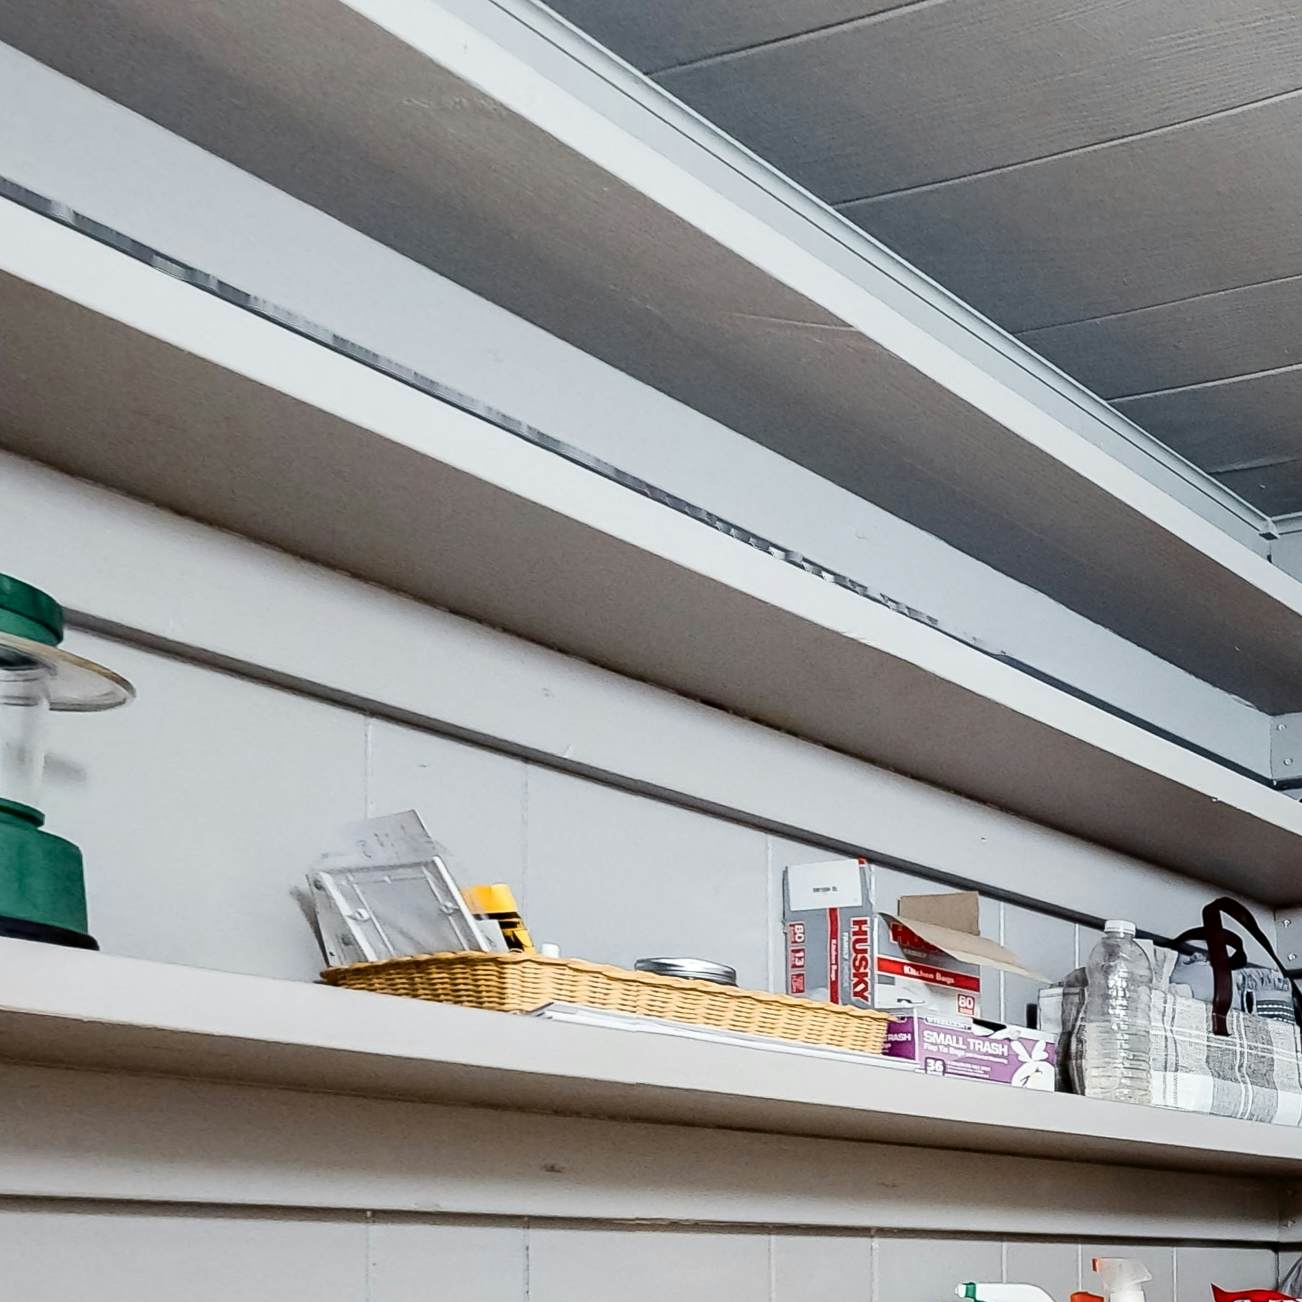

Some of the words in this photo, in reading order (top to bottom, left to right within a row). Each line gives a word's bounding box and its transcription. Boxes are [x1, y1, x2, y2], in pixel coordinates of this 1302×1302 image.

[851, 917, 871, 1005] HUSKY
[903, 964, 933, 981] Kitchen
[935, 971, 955, 985] Bags
[923, 1030, 967, 1050] SMALL
[967, 1038, 1009, 1057] TRASH
[927, 1059, 944, 1072] 36
